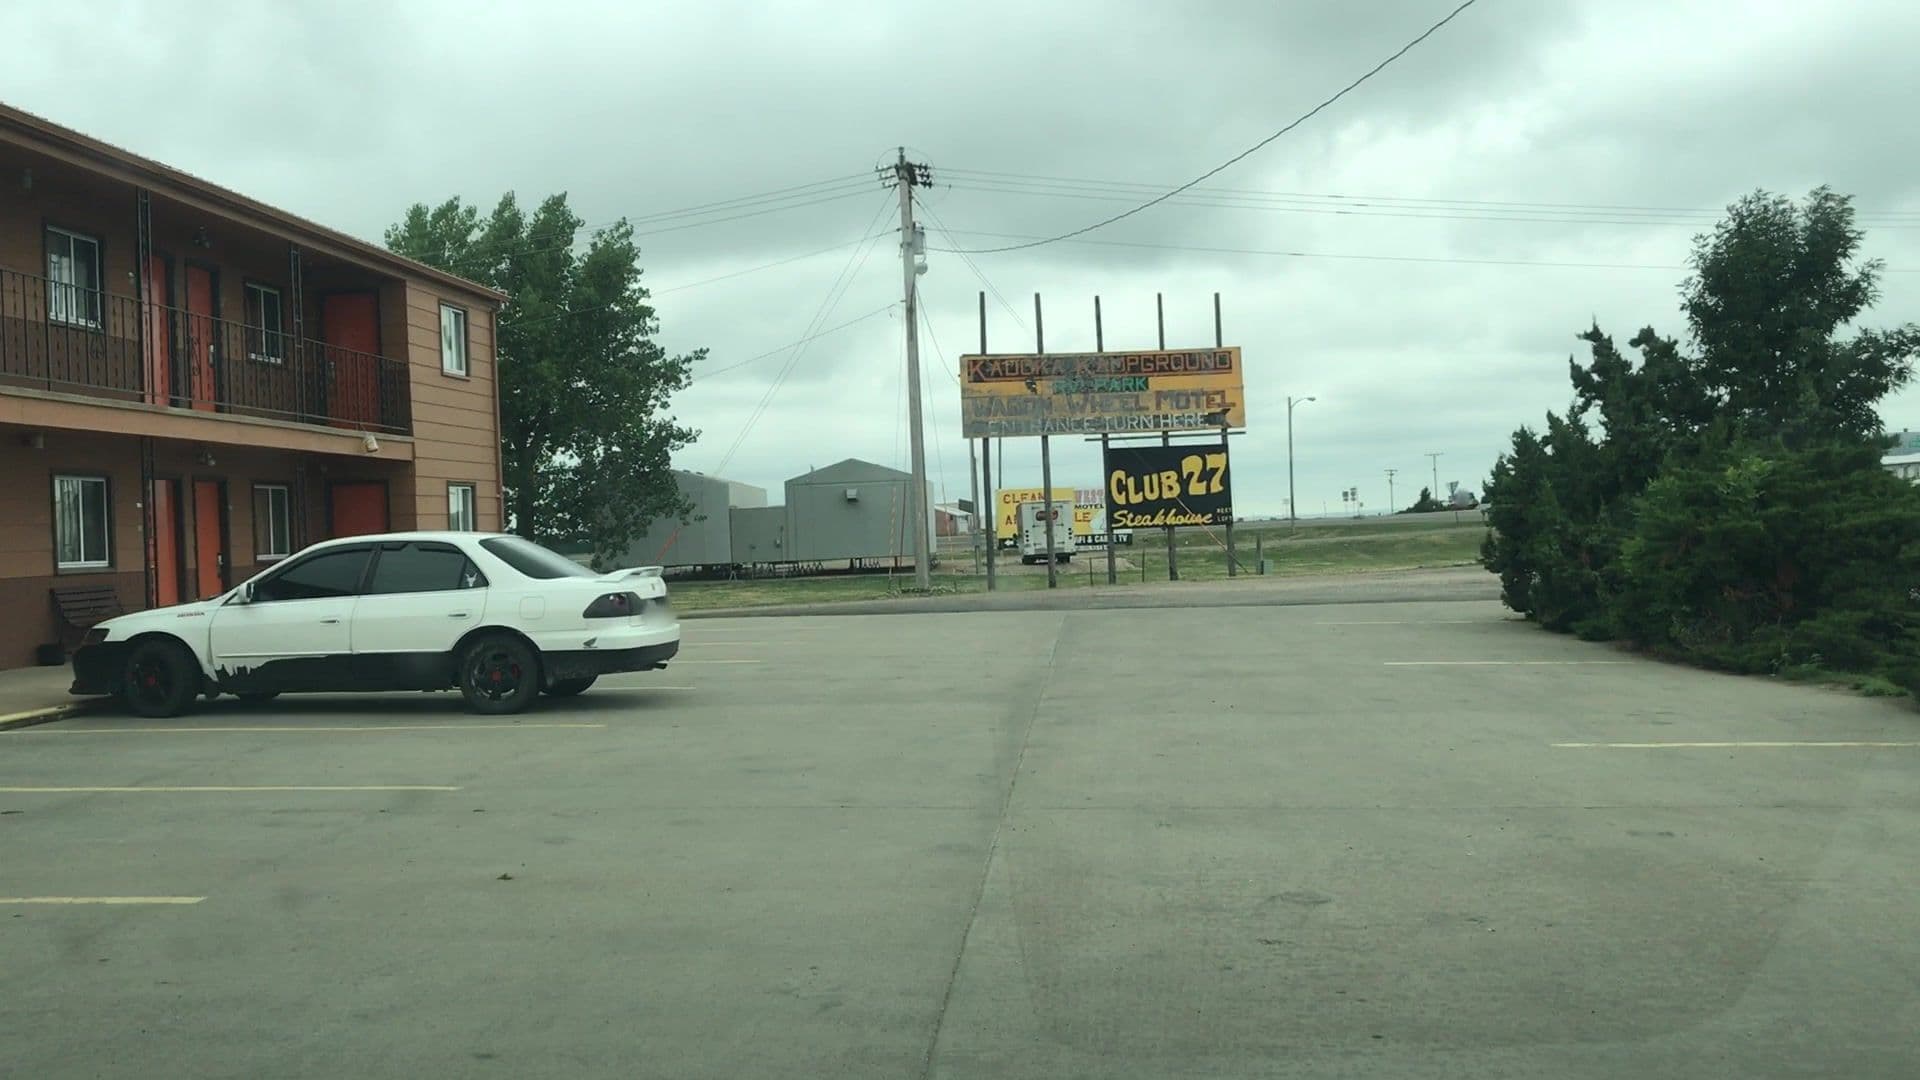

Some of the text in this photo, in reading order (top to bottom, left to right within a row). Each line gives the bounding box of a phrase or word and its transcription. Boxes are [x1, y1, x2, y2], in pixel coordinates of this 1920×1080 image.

[1095, 376, 1147, 392] PARK
[1155, 389, 1236, 411] MOTEL
[1103, 414, 1154, 431] TURN
[1160, 411, 1209, 428] HERE
[1111, 452, 1227, 505] CLUB 27
[1111, 508, 1213, 528] Steakhouse
